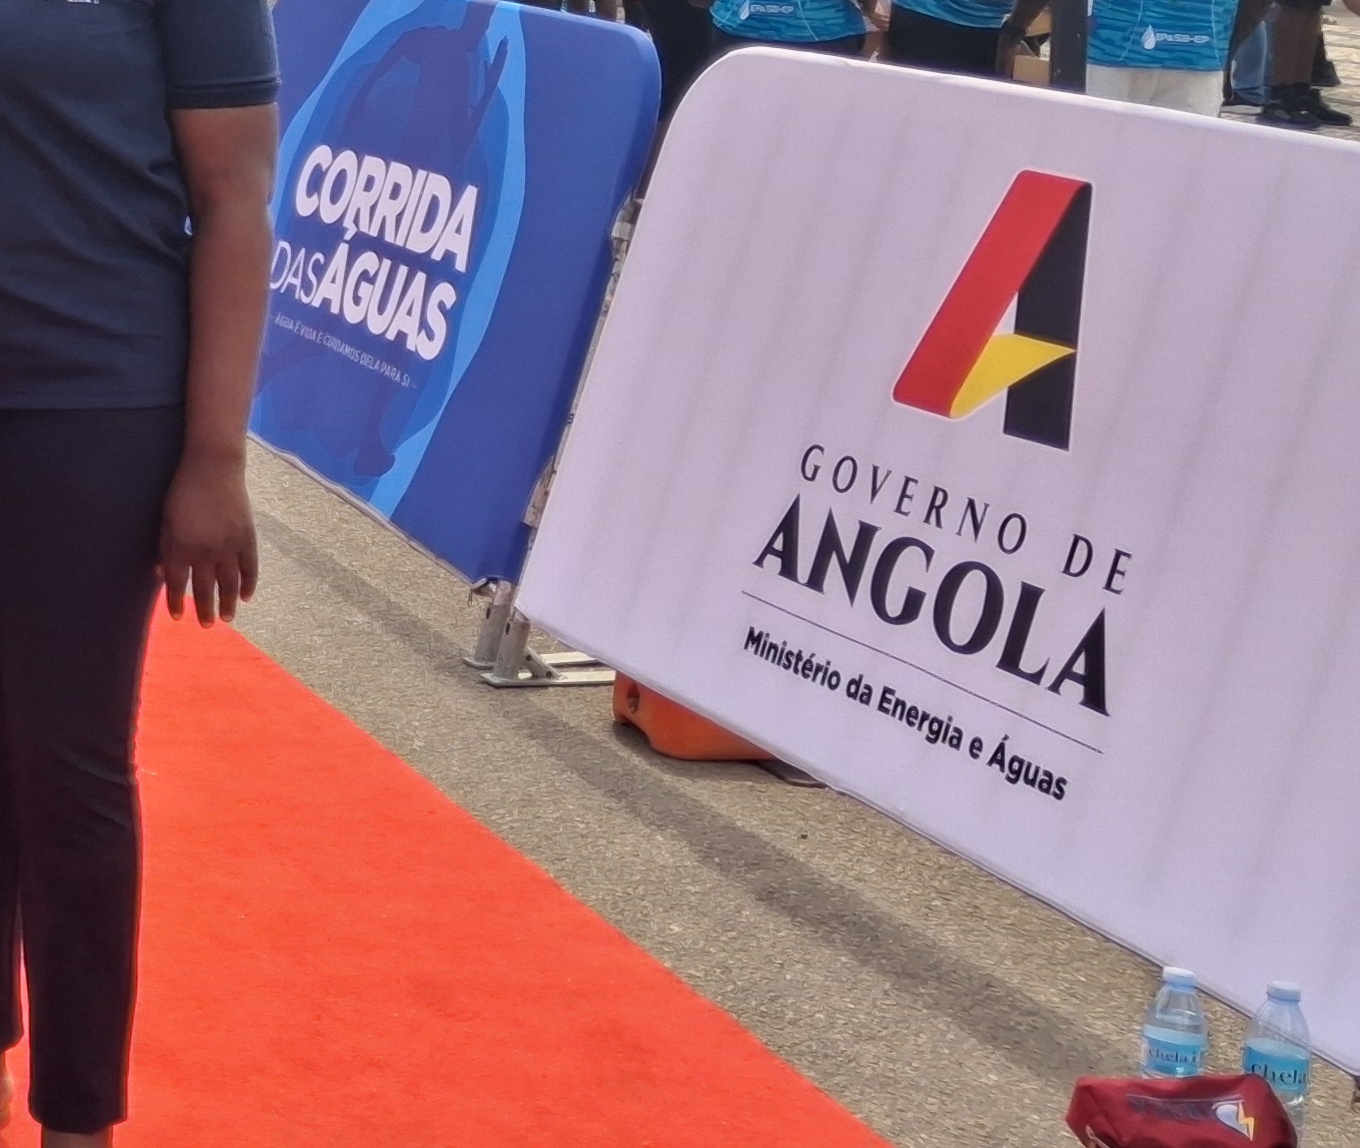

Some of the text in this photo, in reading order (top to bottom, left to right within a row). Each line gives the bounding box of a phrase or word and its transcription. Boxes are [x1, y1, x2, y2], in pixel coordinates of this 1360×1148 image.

[294, 142, 479, 274] CORRIDA
[799, 443, 1133, 595] GOVERNO DE
[752, 492, 1111, 717] ANGOLA
[743, 625, 1069, 802] Ministério da Energia e Águas
